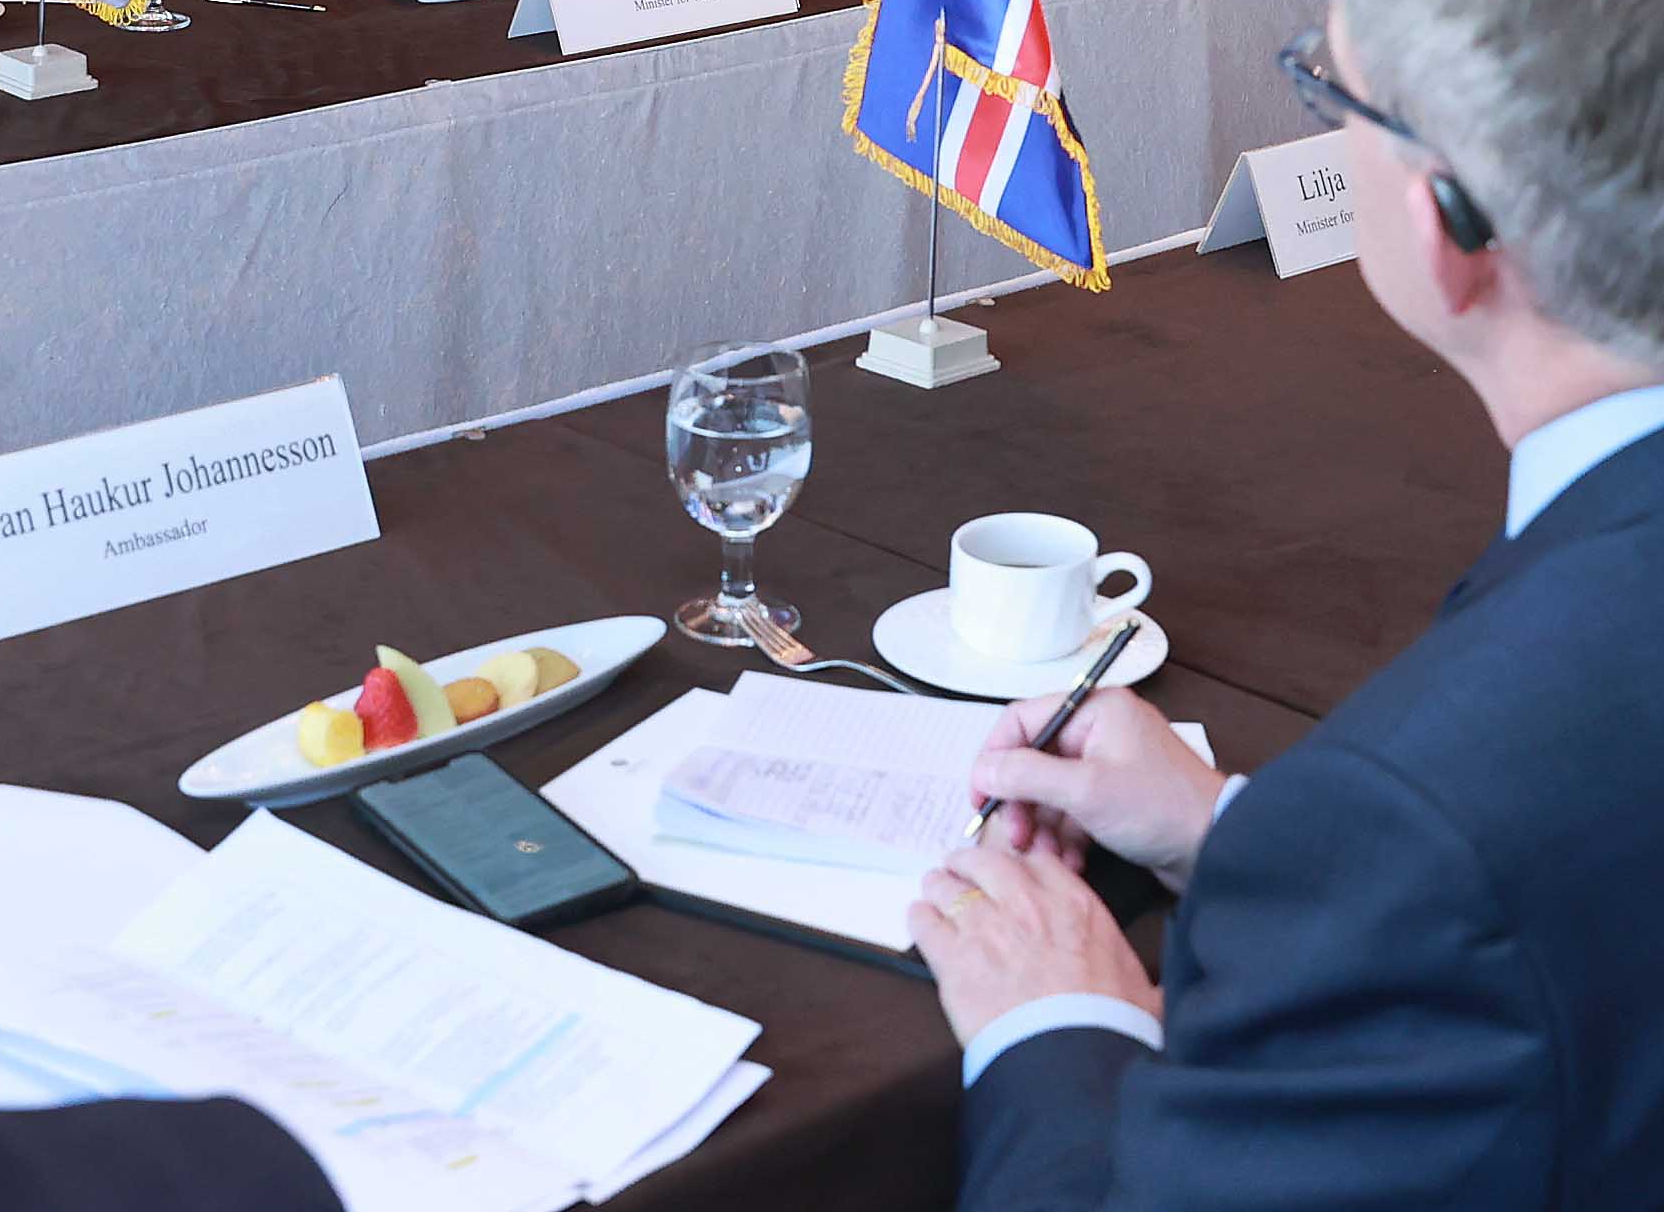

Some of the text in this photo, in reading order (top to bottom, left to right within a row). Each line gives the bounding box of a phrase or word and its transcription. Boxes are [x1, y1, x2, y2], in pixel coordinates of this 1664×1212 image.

[1297, 167, 1346, 202] Lilja
[1296, 209, 1354, 236] Minister for
[42, 477, 153, 528] Haukur
[162, 431, 338, 499] Johannesson
[103, 517, 209, 560] Ambassador
